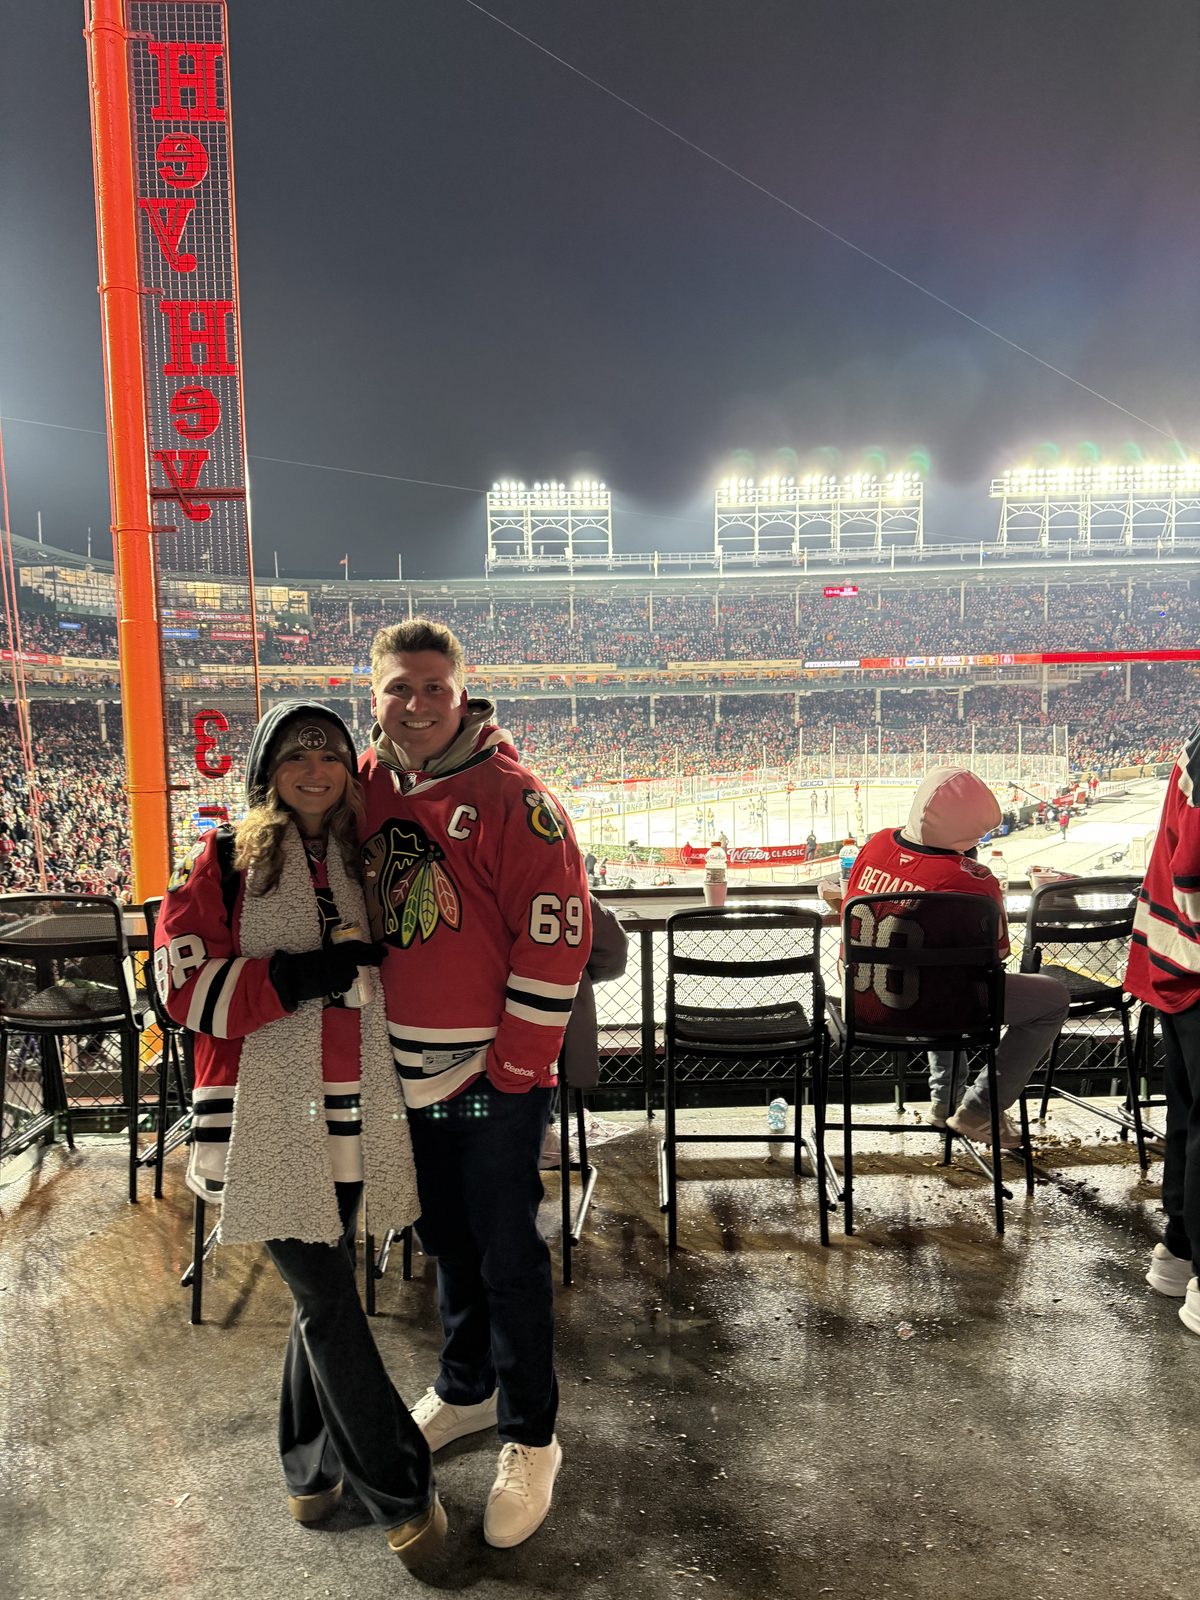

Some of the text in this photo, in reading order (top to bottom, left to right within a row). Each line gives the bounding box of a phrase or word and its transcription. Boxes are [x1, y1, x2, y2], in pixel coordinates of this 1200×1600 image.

[448, 803, 478, 840] C
[727, 847, 770, 863] Winter
[771, 848, 805, 858] CLASSIC
[530, 893, 583, 946] 69
[503, 1061, 536, 1078] Reebok
